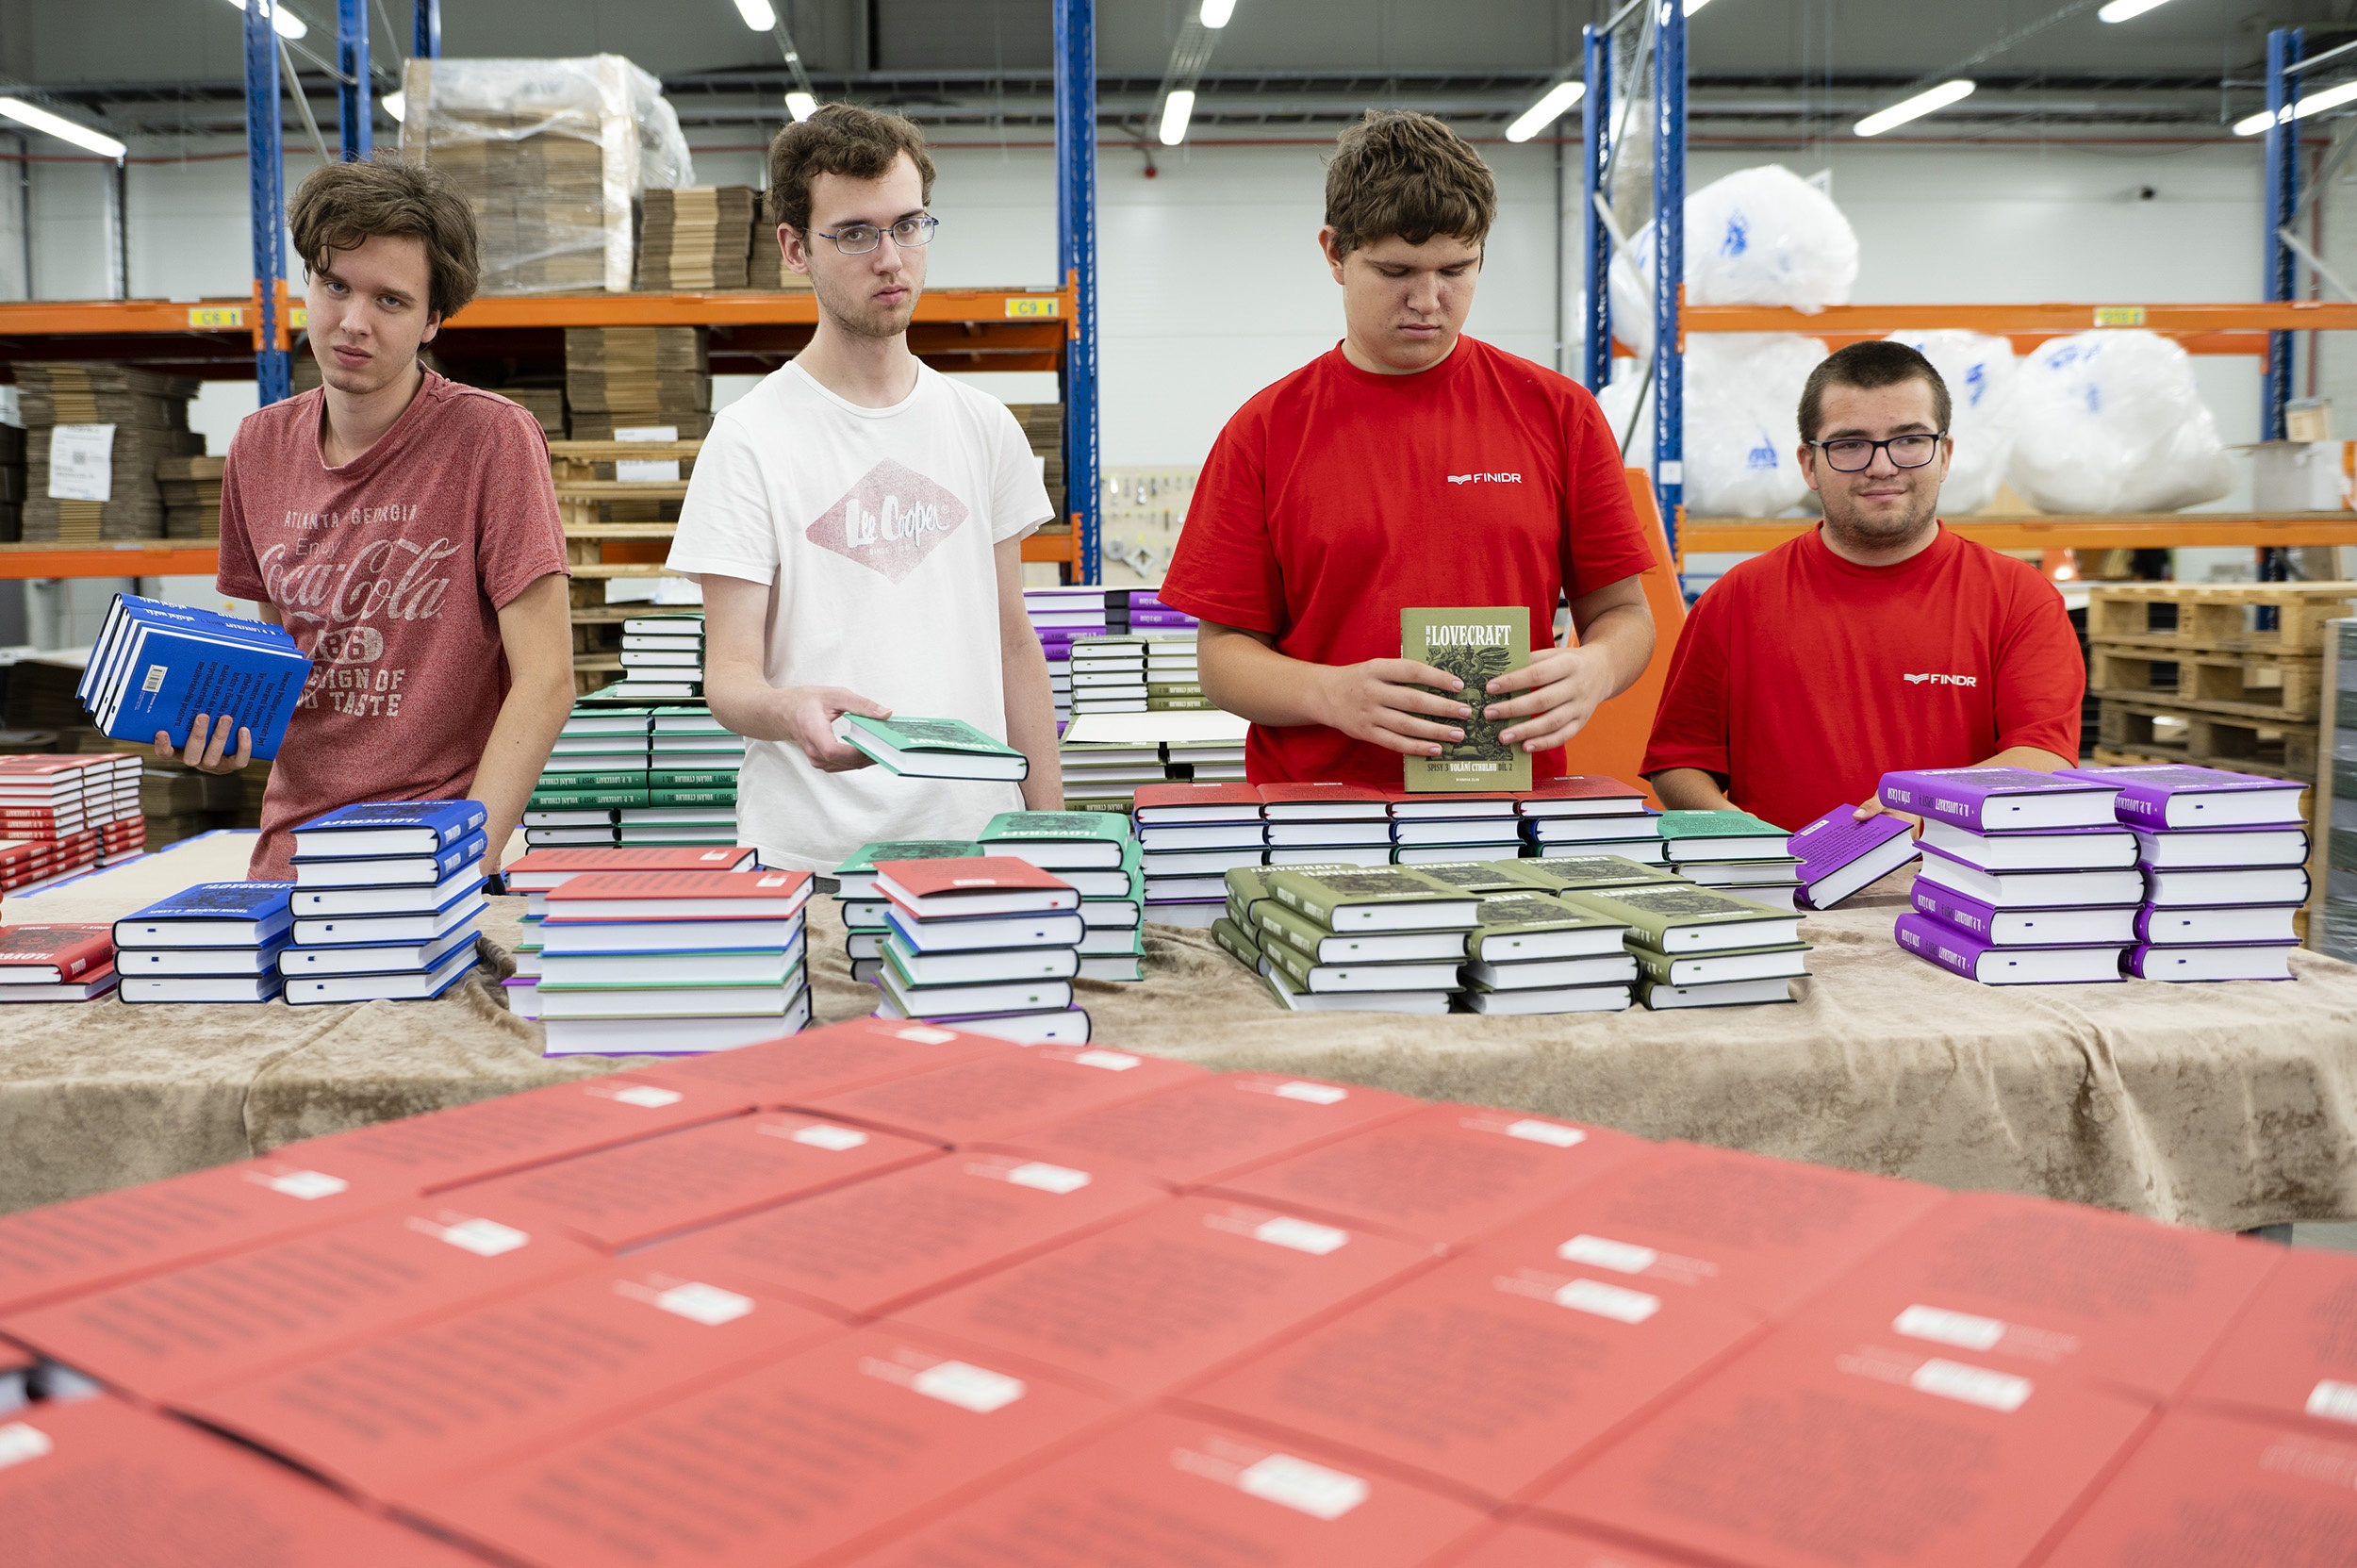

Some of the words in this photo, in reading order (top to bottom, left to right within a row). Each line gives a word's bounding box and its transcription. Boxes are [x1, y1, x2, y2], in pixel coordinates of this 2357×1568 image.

[1474, 472, 1522, 484] FINIDR
[285, 510, 339, 530] ATLANTA
[351, 503, 417, 525] GEORGIA
[845, 498, 878, 548] Lee
[881, 495, 949, 548] Cooper
[295, 537, 341, 560] Enjoy
[259, 537, 463, 623] Coca-Cola
[1431, 625, 1511, 646] LOVECRAFT
[279, 670, 293, 691] Howard
[307, 666, 370, 689] EIGN
[375, 668, 405, 692] OF
[269, 690, 285, 712] Phillips
[329, 691, 402, 717] TASTE
[261, 711, 276, 736] Lovecraft
[1427, 763, 1443, 771] SPISY
[1445, 763, 1449, 771] 3
[1450, 761, 1471, 772] VOLÁNÍ
[1472, 763, 1496, 771] CTHULHU
[1498, 762, 1508, 771] DÍL
[1509, 763, 1512, 771] 2
[1935, 798, 1958, 815] LOVECRAFT
[2114, 797, 2138, 813] LOVECRAF
